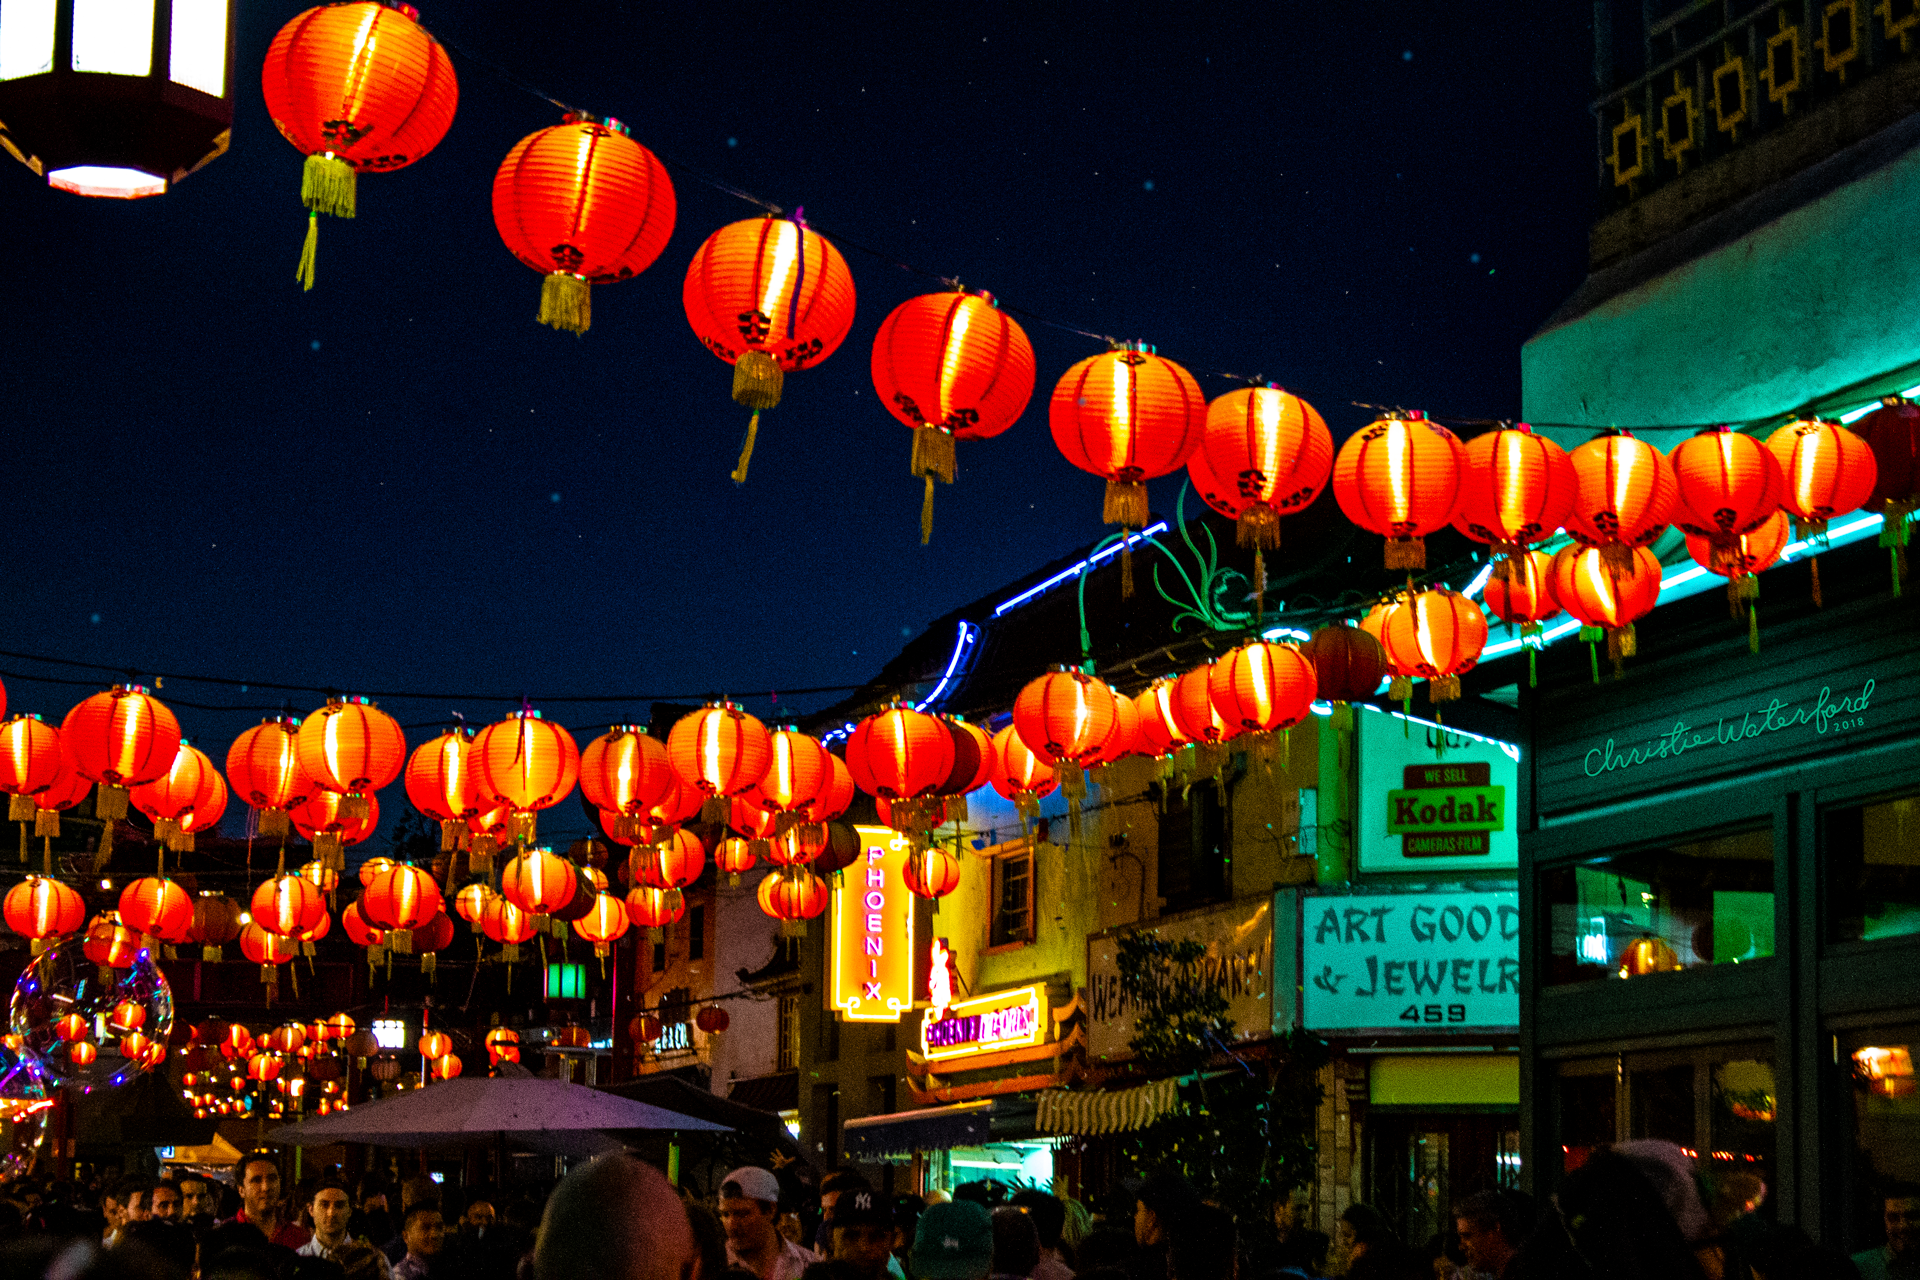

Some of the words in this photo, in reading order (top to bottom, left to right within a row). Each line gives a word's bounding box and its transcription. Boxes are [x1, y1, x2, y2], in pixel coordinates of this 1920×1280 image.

[1425, 769, 1441, 783] WE
[1444, 768, 1467, 782] SELL
[1394, 794, 1498, 826] Kodak
[865, 845, 886, 1001] PHOENIX
[1315, 905, 1395, 944] ART
[1313, 964, 1348, 994] &
[1399, 1003, 1466, 1023] 459
